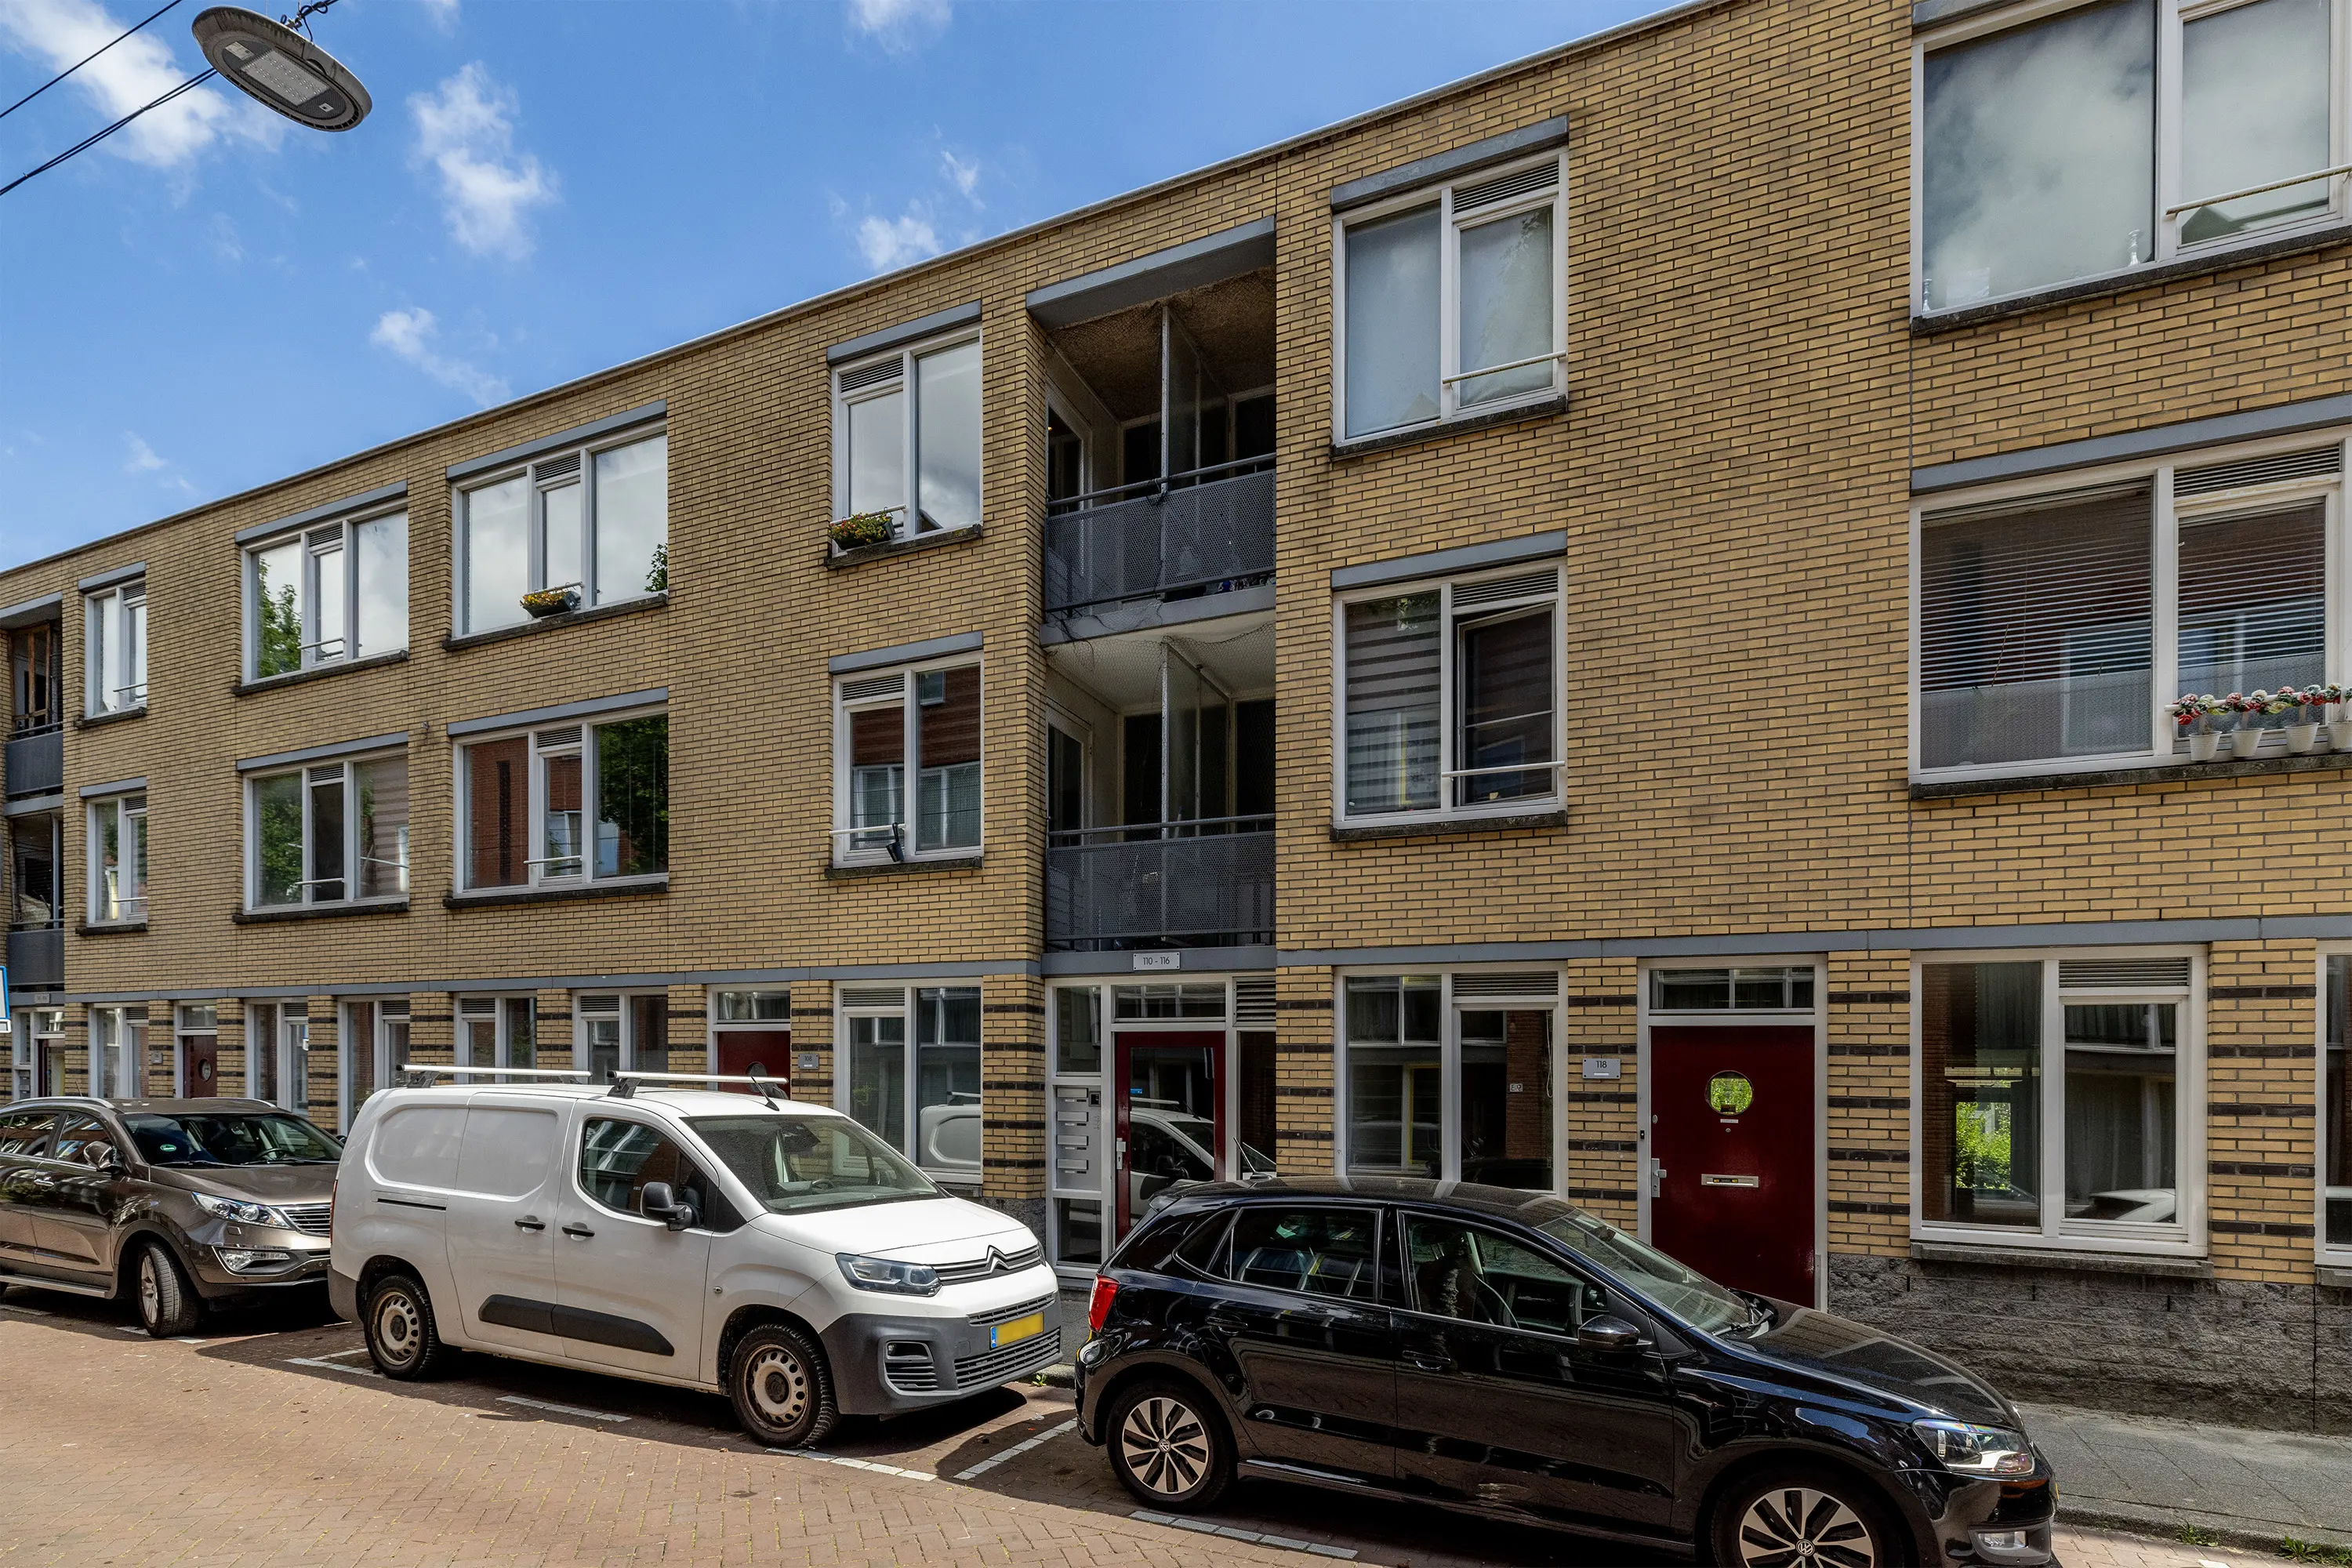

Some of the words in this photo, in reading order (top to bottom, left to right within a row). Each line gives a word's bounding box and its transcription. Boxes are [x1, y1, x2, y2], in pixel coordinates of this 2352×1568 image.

[1143, 956, 1153, 965] 110
[1160, 956, 1171, 965] 116
[1596, 1060, 1607, 1069] 118
